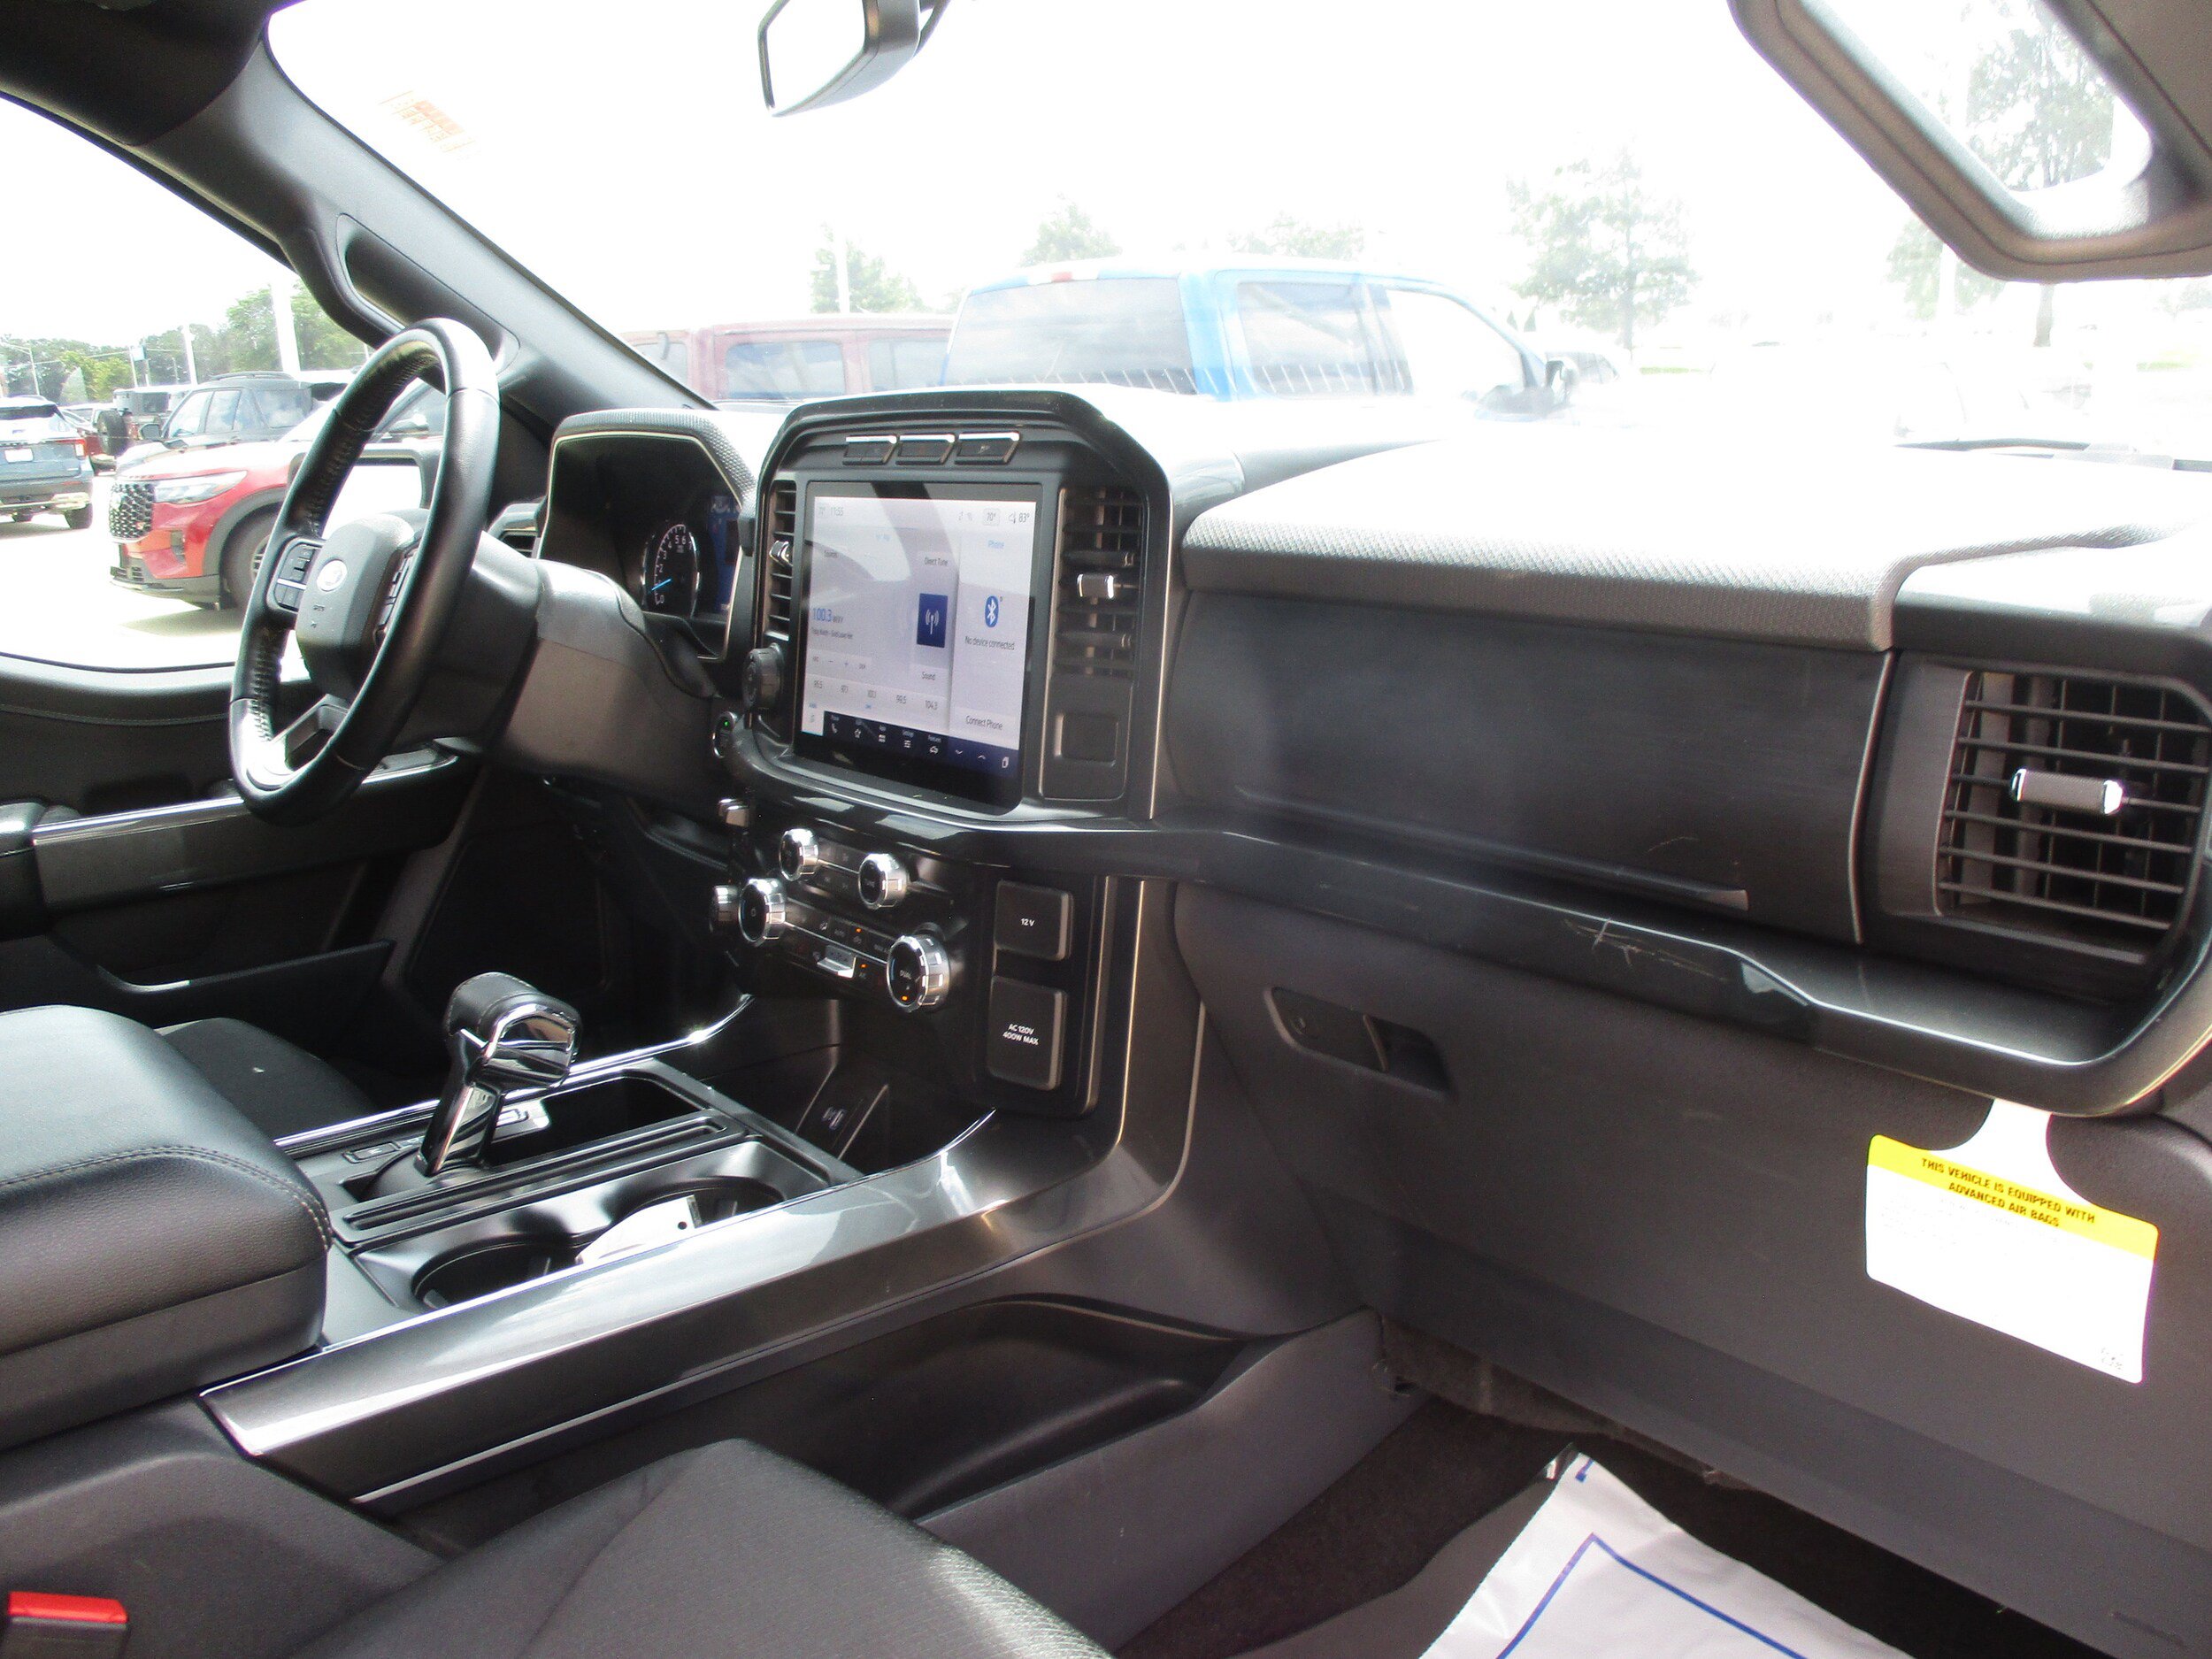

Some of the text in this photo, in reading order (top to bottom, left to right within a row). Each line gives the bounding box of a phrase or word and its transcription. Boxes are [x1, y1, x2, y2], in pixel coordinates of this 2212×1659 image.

[972, 637, 987, 648] device
[988, 640, 1015, 651] connected
[921, 672, 936, 681] Sound
[965, 715, 1002, 731] Connect Phone
[1018, 1025, 1034, 1035] 120V
[1002, 1031, 1039, 1045] 400W MAX
[1922, 1158, 2095, 1223] THIS VEHICLE IS EQUIPPED WITH
[1948, 1182, 2060, 1226] ADVANCED AIR BAGS
